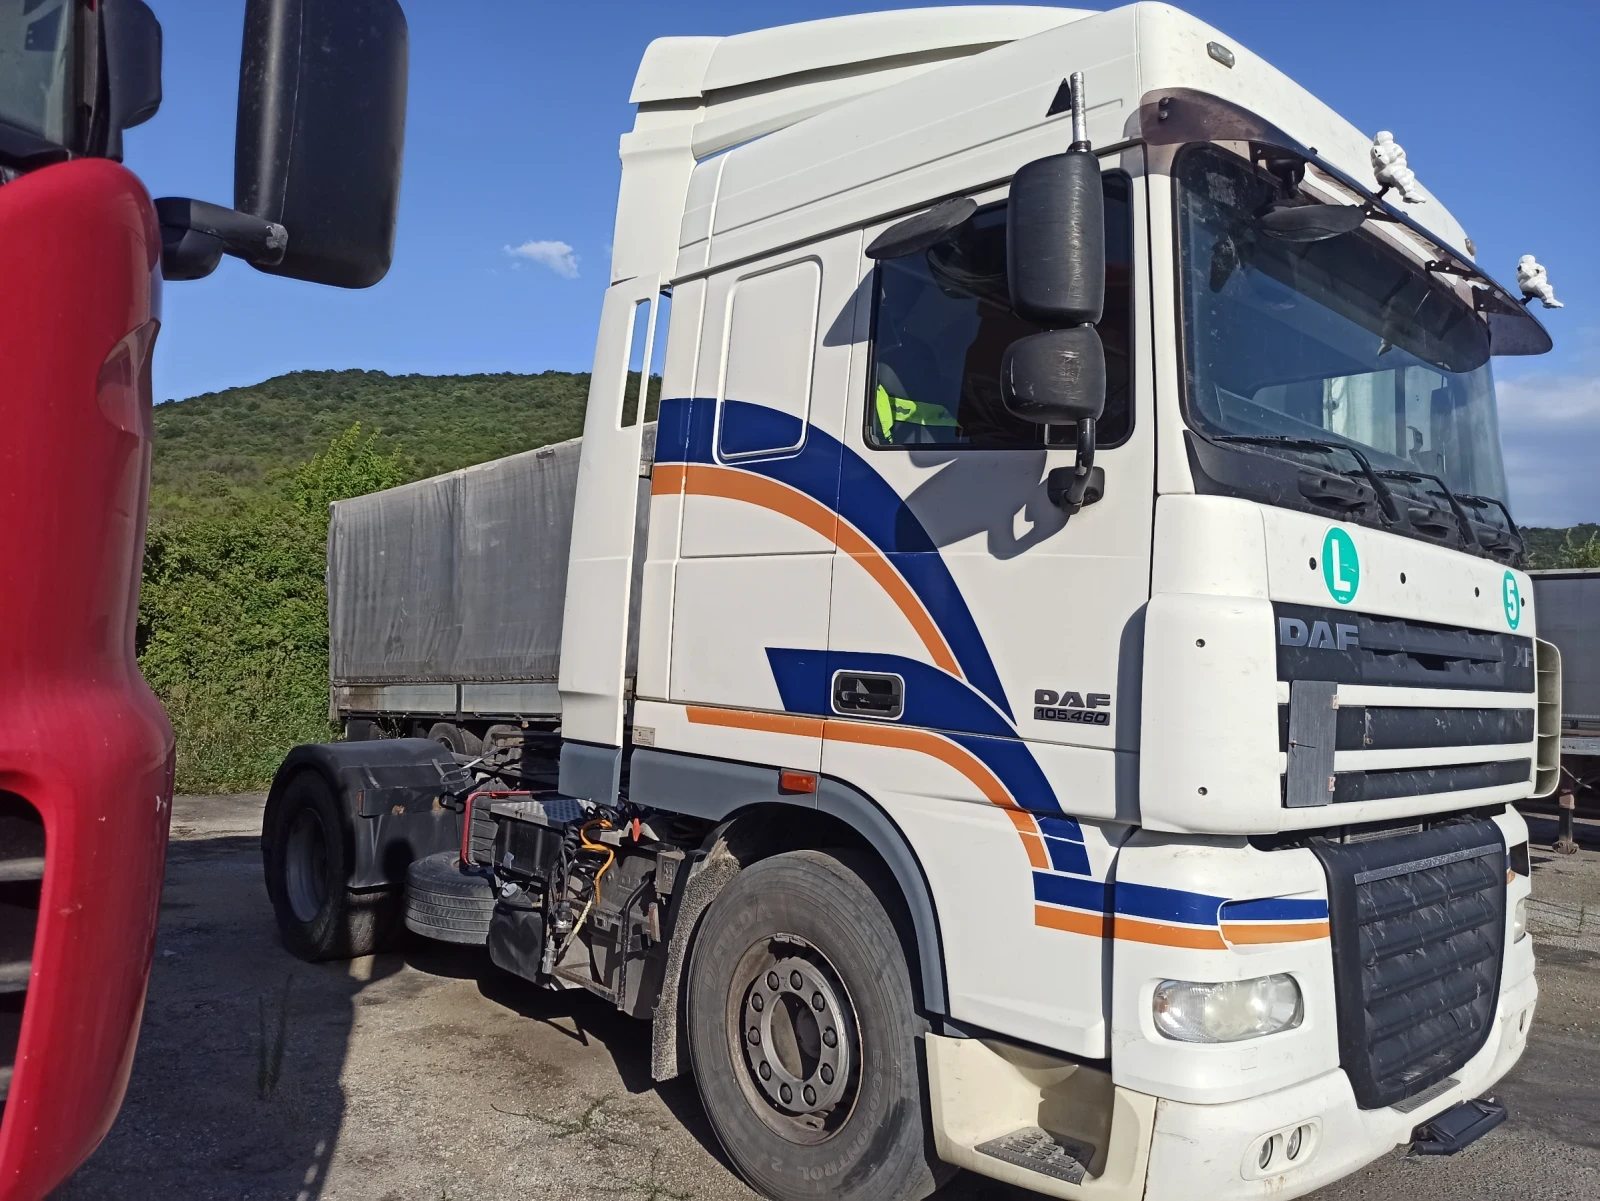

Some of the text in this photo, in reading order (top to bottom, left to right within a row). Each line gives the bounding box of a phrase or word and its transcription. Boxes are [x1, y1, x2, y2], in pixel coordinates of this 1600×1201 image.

[1331, 538, 1351, 592] L
[1505, 578, 1517, 621] 5
[1278, 617, 1359, 651] DAF
[1034, 688, 1111, 709] DAF
[1036, 708, 1108, 724] 105.460
[796, 1050, 884, 1181] ECOCONTROL
